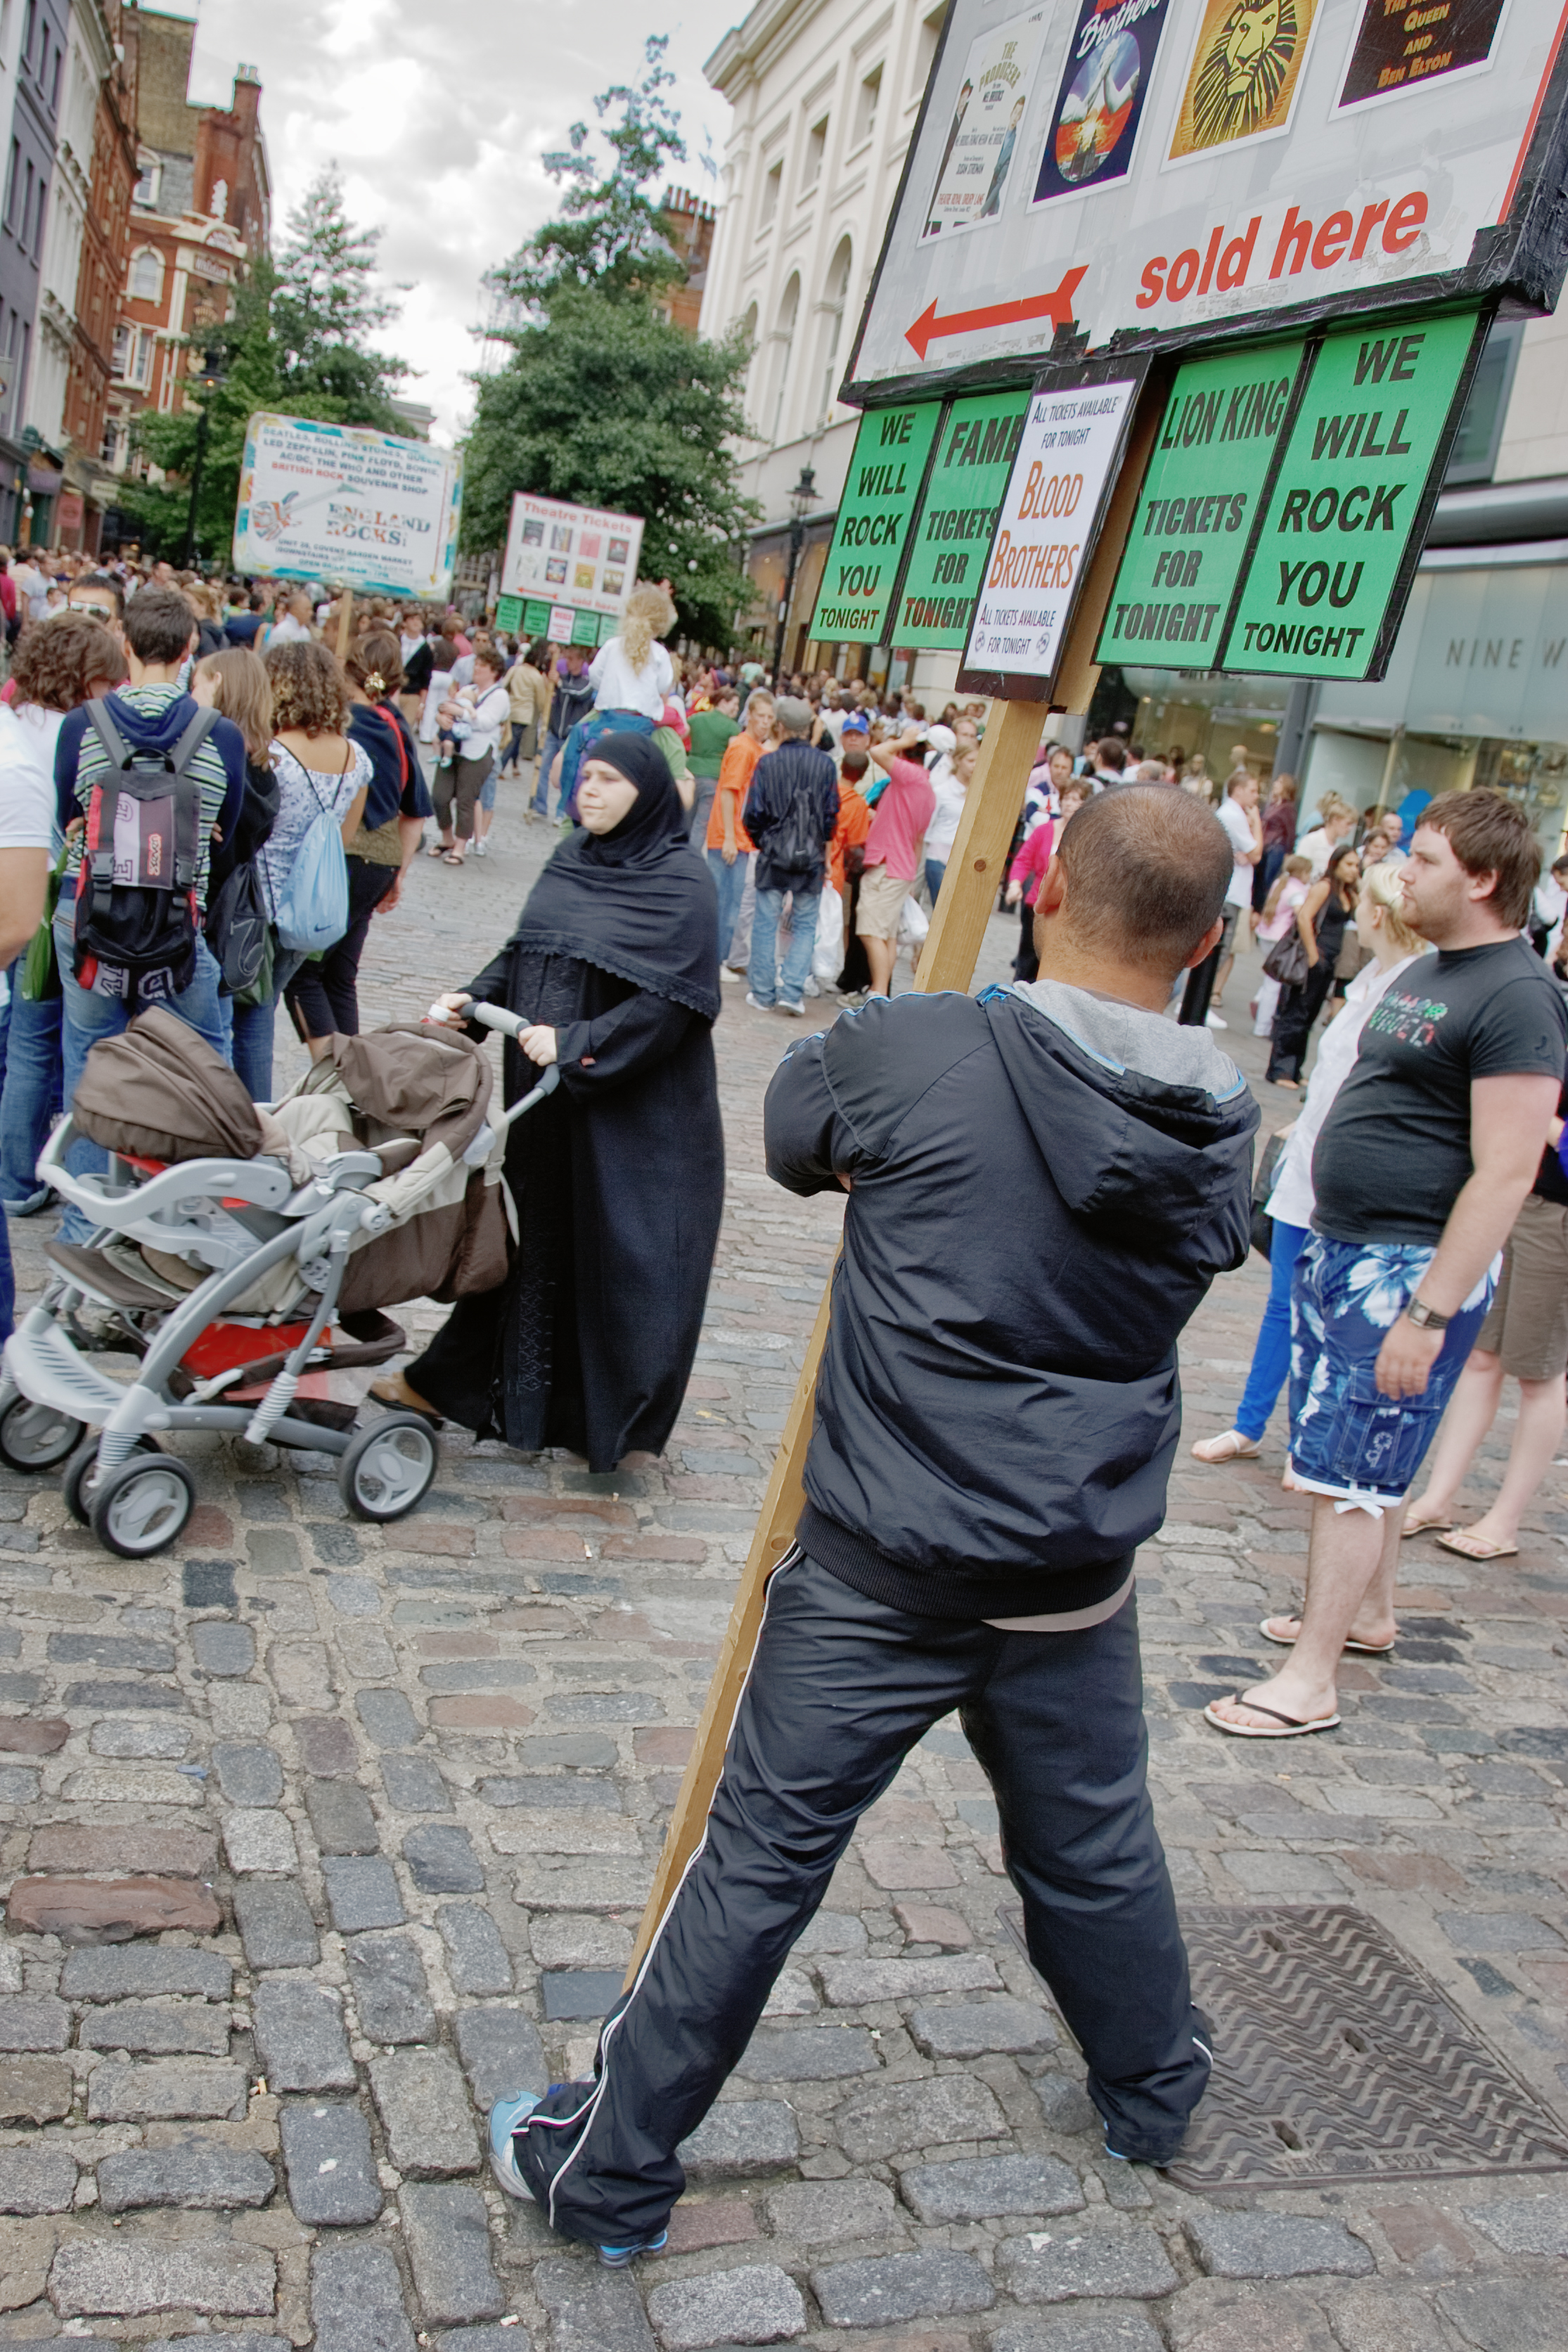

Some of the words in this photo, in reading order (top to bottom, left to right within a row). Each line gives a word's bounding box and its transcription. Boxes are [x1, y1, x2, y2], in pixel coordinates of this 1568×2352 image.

[1001, 41, 1018, 60] THE
[1403, 34, 1433, 56] AND
[978, 61, 1021, 92] PRODUCERS
[1136, 215, 1262, 309] sold
[1268, 191, 1428, 280] here
[1353, 333, 1427, 386] WE
[880, 413, 916, 446] WE
[1160, 387, 1226, 451] LION
[1219, 376, 1290, 443] KING
[1041, 432, 1058, 449] FOR
[1058, 428, 1091, 446] TONIGHT
[1311, 409, 1412, 461] WILL
[858, 463, 907, 497] WILL
[327, 502, 430, 534] ENGLAND
[524, 501, 577, 521] Theatre
[582, 514, 632, 534] Tickets
[925, 506, 999, 541] TICKETS
[1143, 493, 1247, 536] TICKETS
[1277, 483, 1408, 533] ROCK
[840, 513, 904, 547] ROCK
[837, 565, 882, 596] YOU
[932, 553, 970, 584] FOR
[1151, 550, 1204, 588] FOR
[1276, 560, 1365, 608] YOU
[819, 608, 880, 630] TONIGHT
[993, 609, 1017, 626] TICKETS
[1018, 610, 1056, 628] AVAILABLE
[1112, 603, 1221, 643] TONIGHT
[987, 636, 1001, 654] FOR
[1001, 637, 1032, 655] TONIGHT
[1242, 622, 1365, 659] TONIGHT
[1446, 638, 1524, 669] NINE
